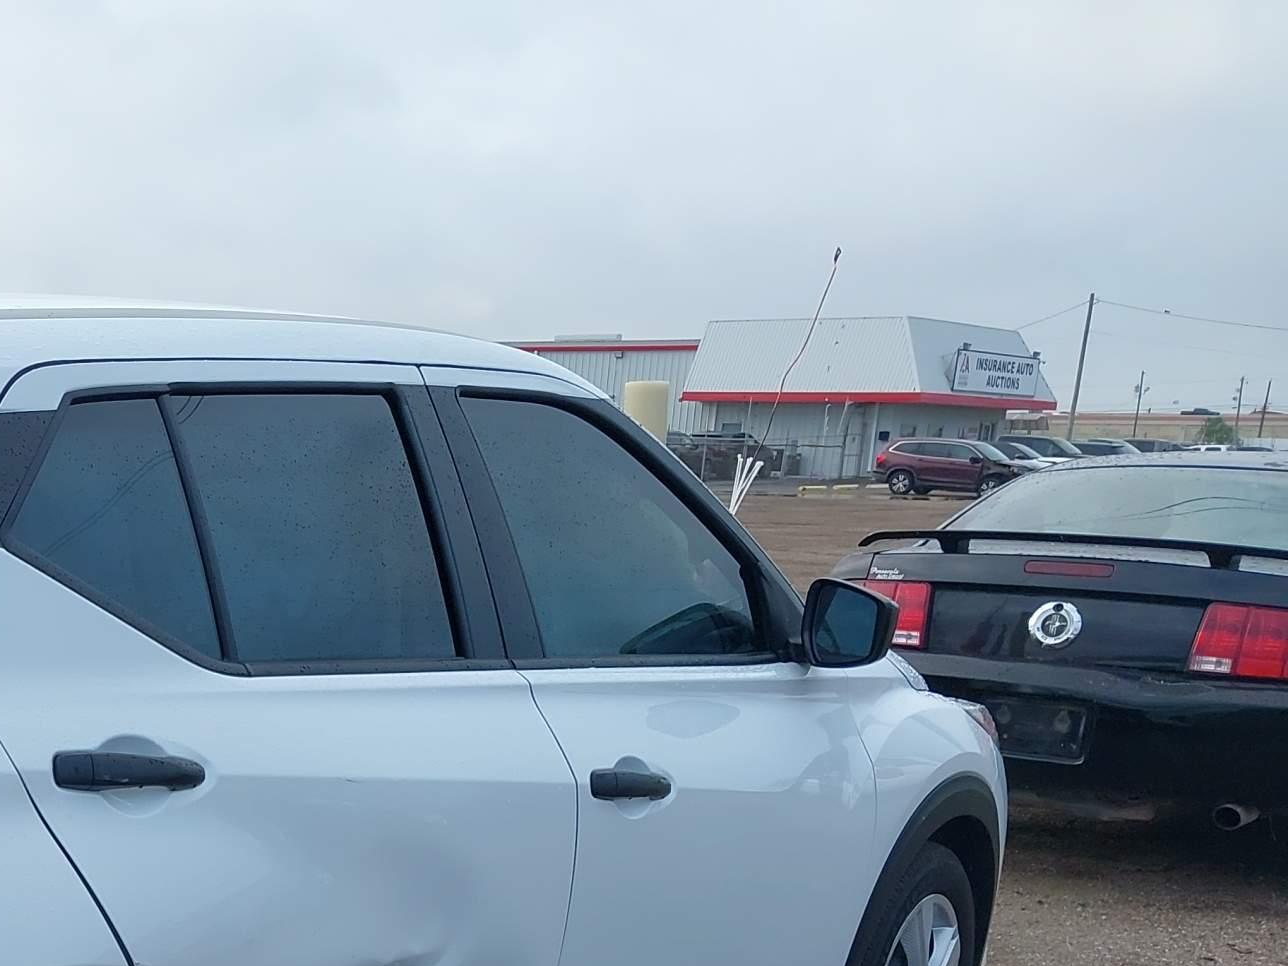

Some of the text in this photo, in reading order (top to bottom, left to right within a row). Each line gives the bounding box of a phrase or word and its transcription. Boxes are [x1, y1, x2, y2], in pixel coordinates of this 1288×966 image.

[975, 357, 1015, 374] INSURANCE
[1016, 363, 1034, 376] AUTO
[985, 375, 1020, 390] AUCTIONS
